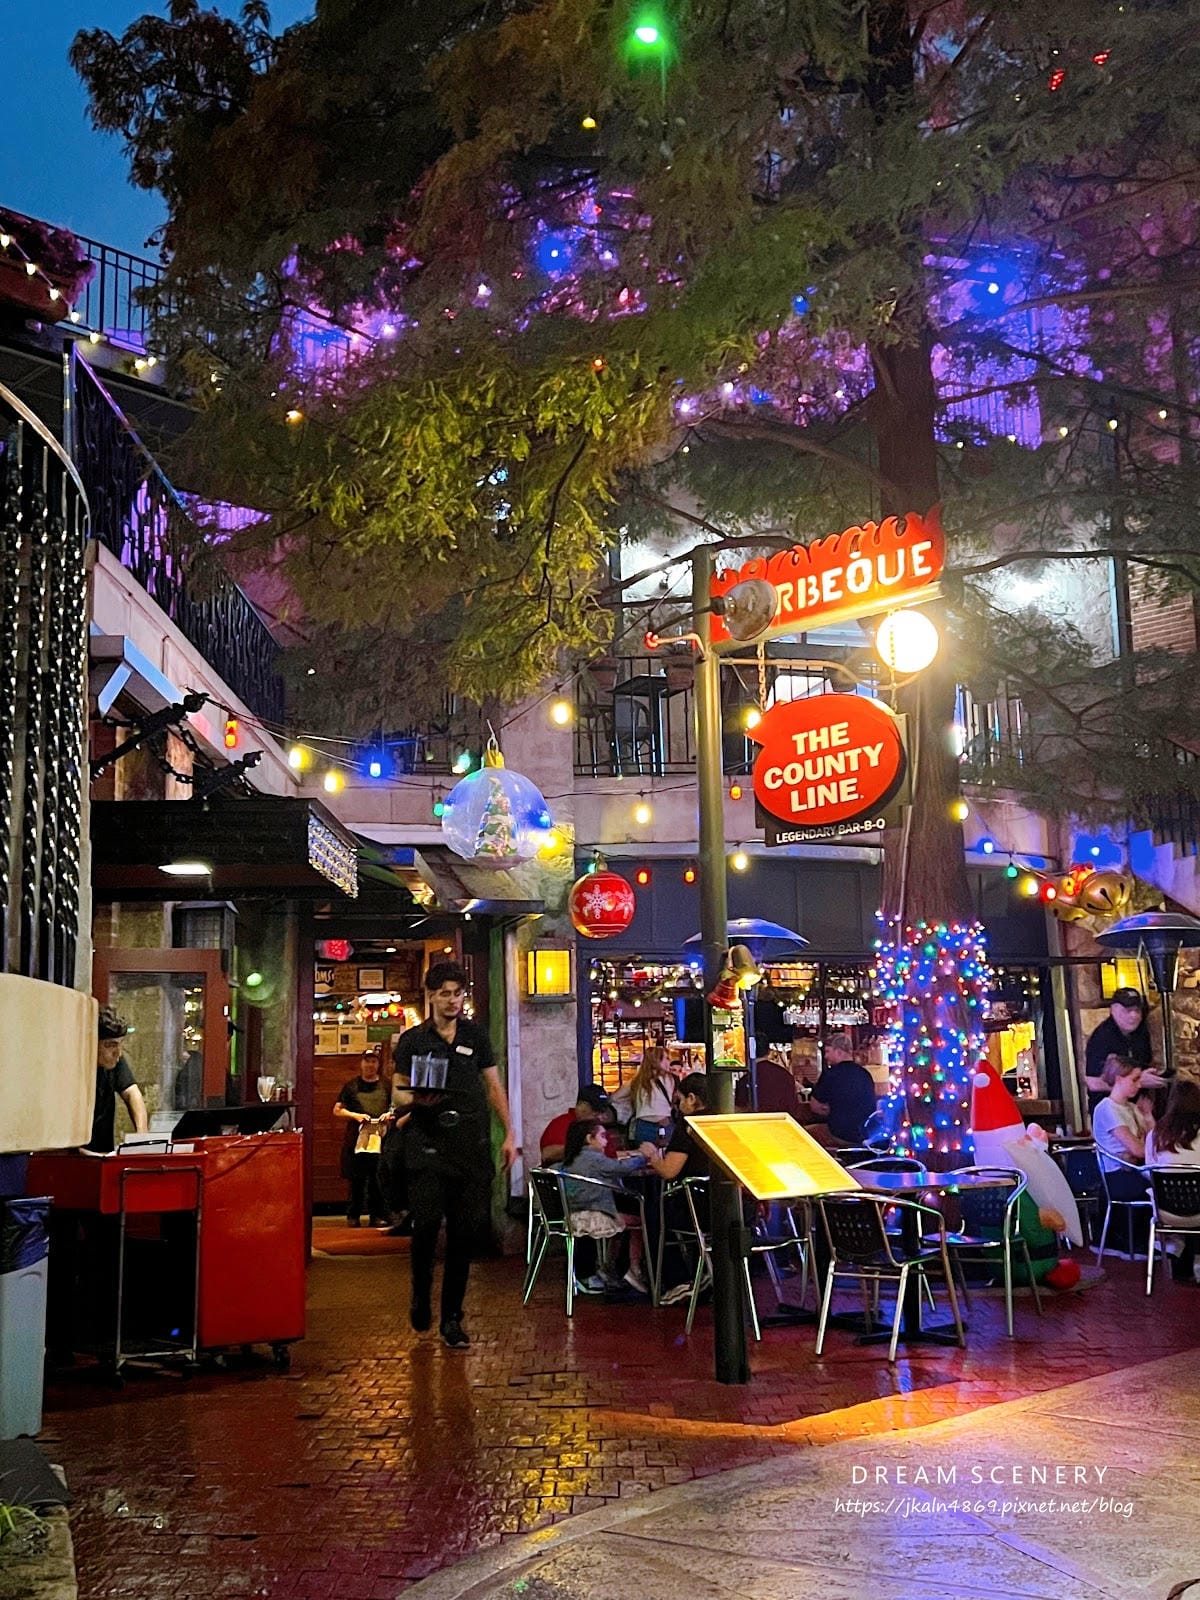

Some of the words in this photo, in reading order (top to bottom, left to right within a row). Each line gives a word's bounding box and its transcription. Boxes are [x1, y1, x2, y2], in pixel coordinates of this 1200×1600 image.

[775, 541, 932, 616] RBEQUE
[791, 721, 850, 756] THE
[763, 742, 884, 790] COUNTY
[775, 825, 836, 844] LEGENDARY
[838, 818, 886, 835] BAR-B-Q
